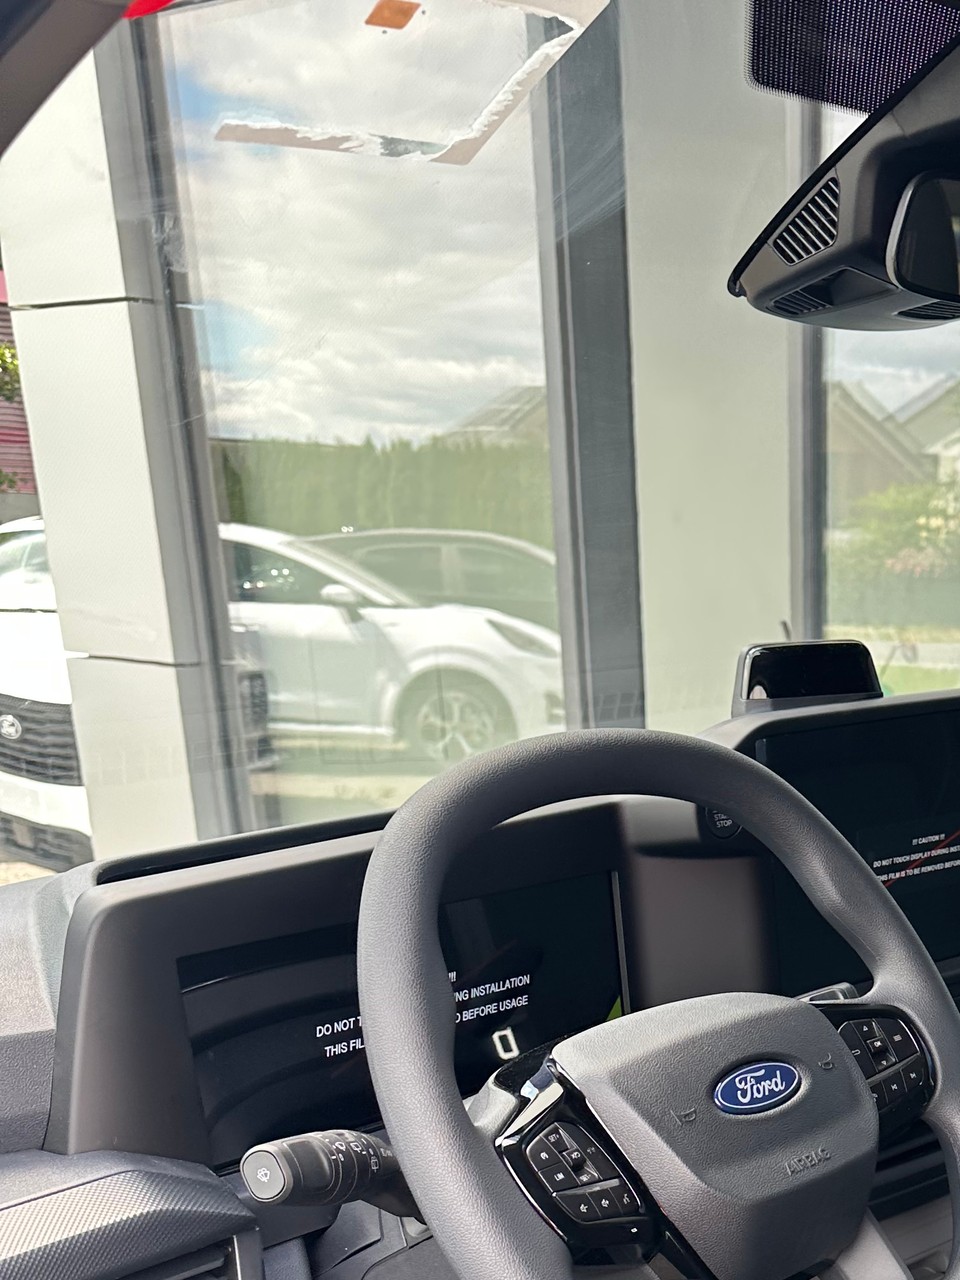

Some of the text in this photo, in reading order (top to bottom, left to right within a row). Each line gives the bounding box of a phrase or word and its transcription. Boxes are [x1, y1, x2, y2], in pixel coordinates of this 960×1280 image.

[716, 819, 733, 828] STOP
[918, 835, 940, 845] CAUTION
[873, 860, 881, 868] DO
[882, 858, 892, 866] NOT
[893, 855, 910, 864] TOUCH
[910, 851, 931, 861] DISPLAY
[931, 847, 949, 857] DURING
[888, 871, 900, 880] FILM
[900, 870, 906, 878] IS
[913, 867, 920, 875] BE
[921, 862, 945, 873] REMOVED
[316, 1023, 332, 1038] DO
[333, 1017, 356, 1033] NOT
[470, 974, 530, 998] INSTALLATION
[324, 1041, 348, 1057] THIS
[349, 1037, 365, 1051] FIL
[462, 1002, 498, 1022] BEFORE
[499, 994, 529, 1012] USAGE
[735, 1069, 786, 1104] Ford
[553, 1171, 565, 1182] LIM
